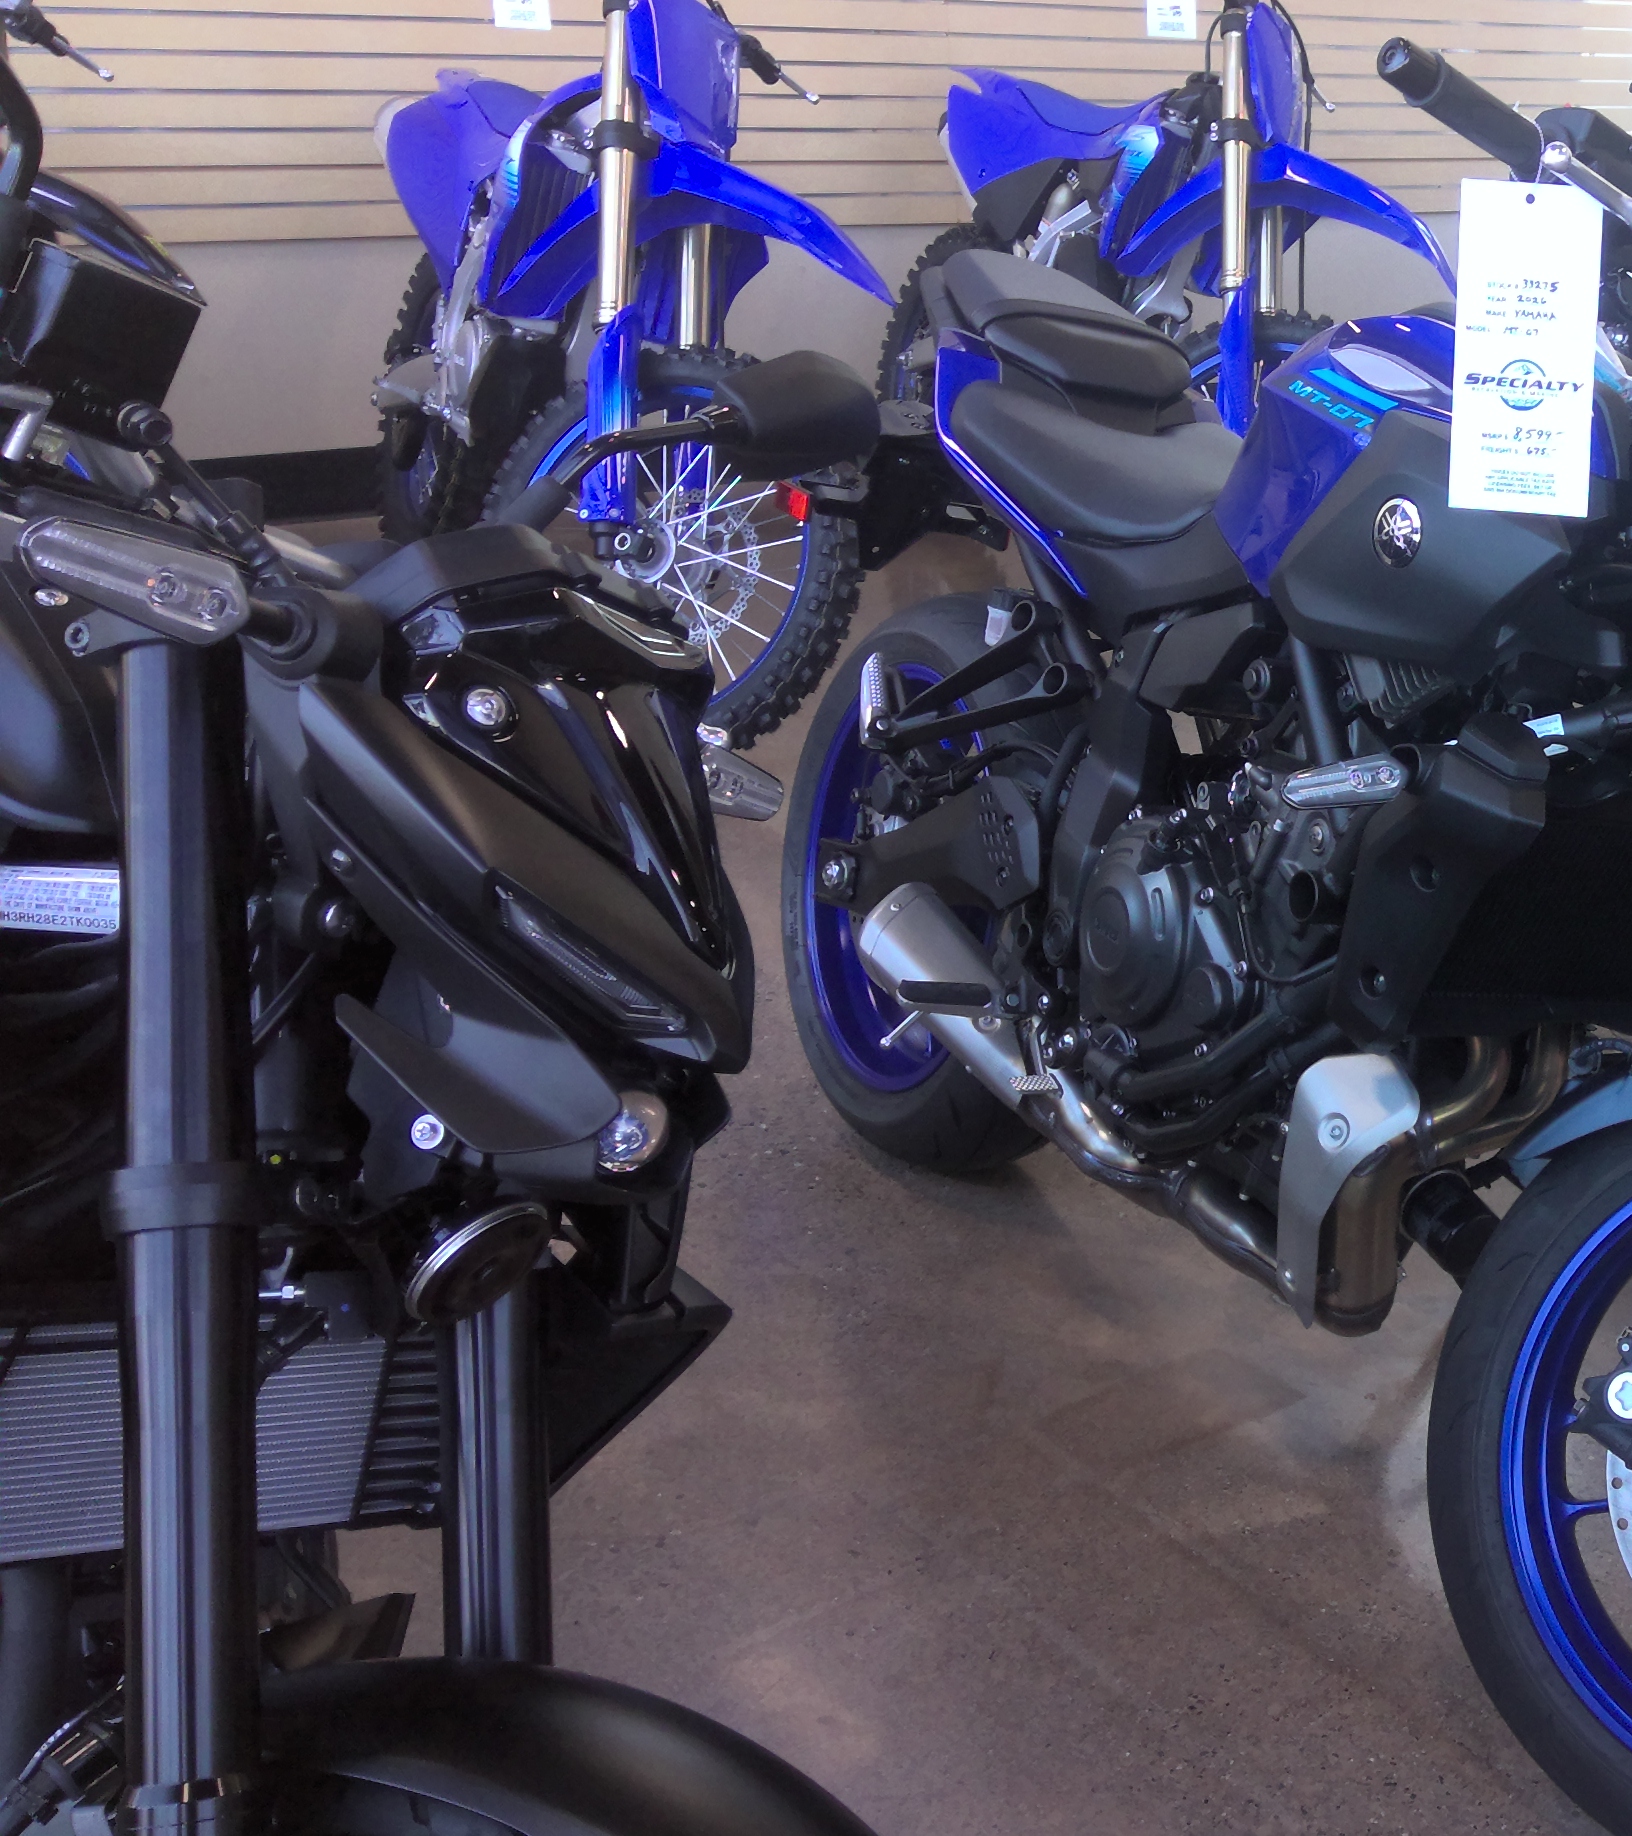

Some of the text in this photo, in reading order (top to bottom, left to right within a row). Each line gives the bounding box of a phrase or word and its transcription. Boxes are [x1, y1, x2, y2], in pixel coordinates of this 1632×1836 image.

[1516, 294, 1547, 305] 2026
[1514, 309, 1557, 321] YAMAHA
[1463, 372, 1585, 392] SPECIALTY
[1288, 379, 1375, 429] MT-07
[0, 909, 117, 930] H3RH28E2TK0035
